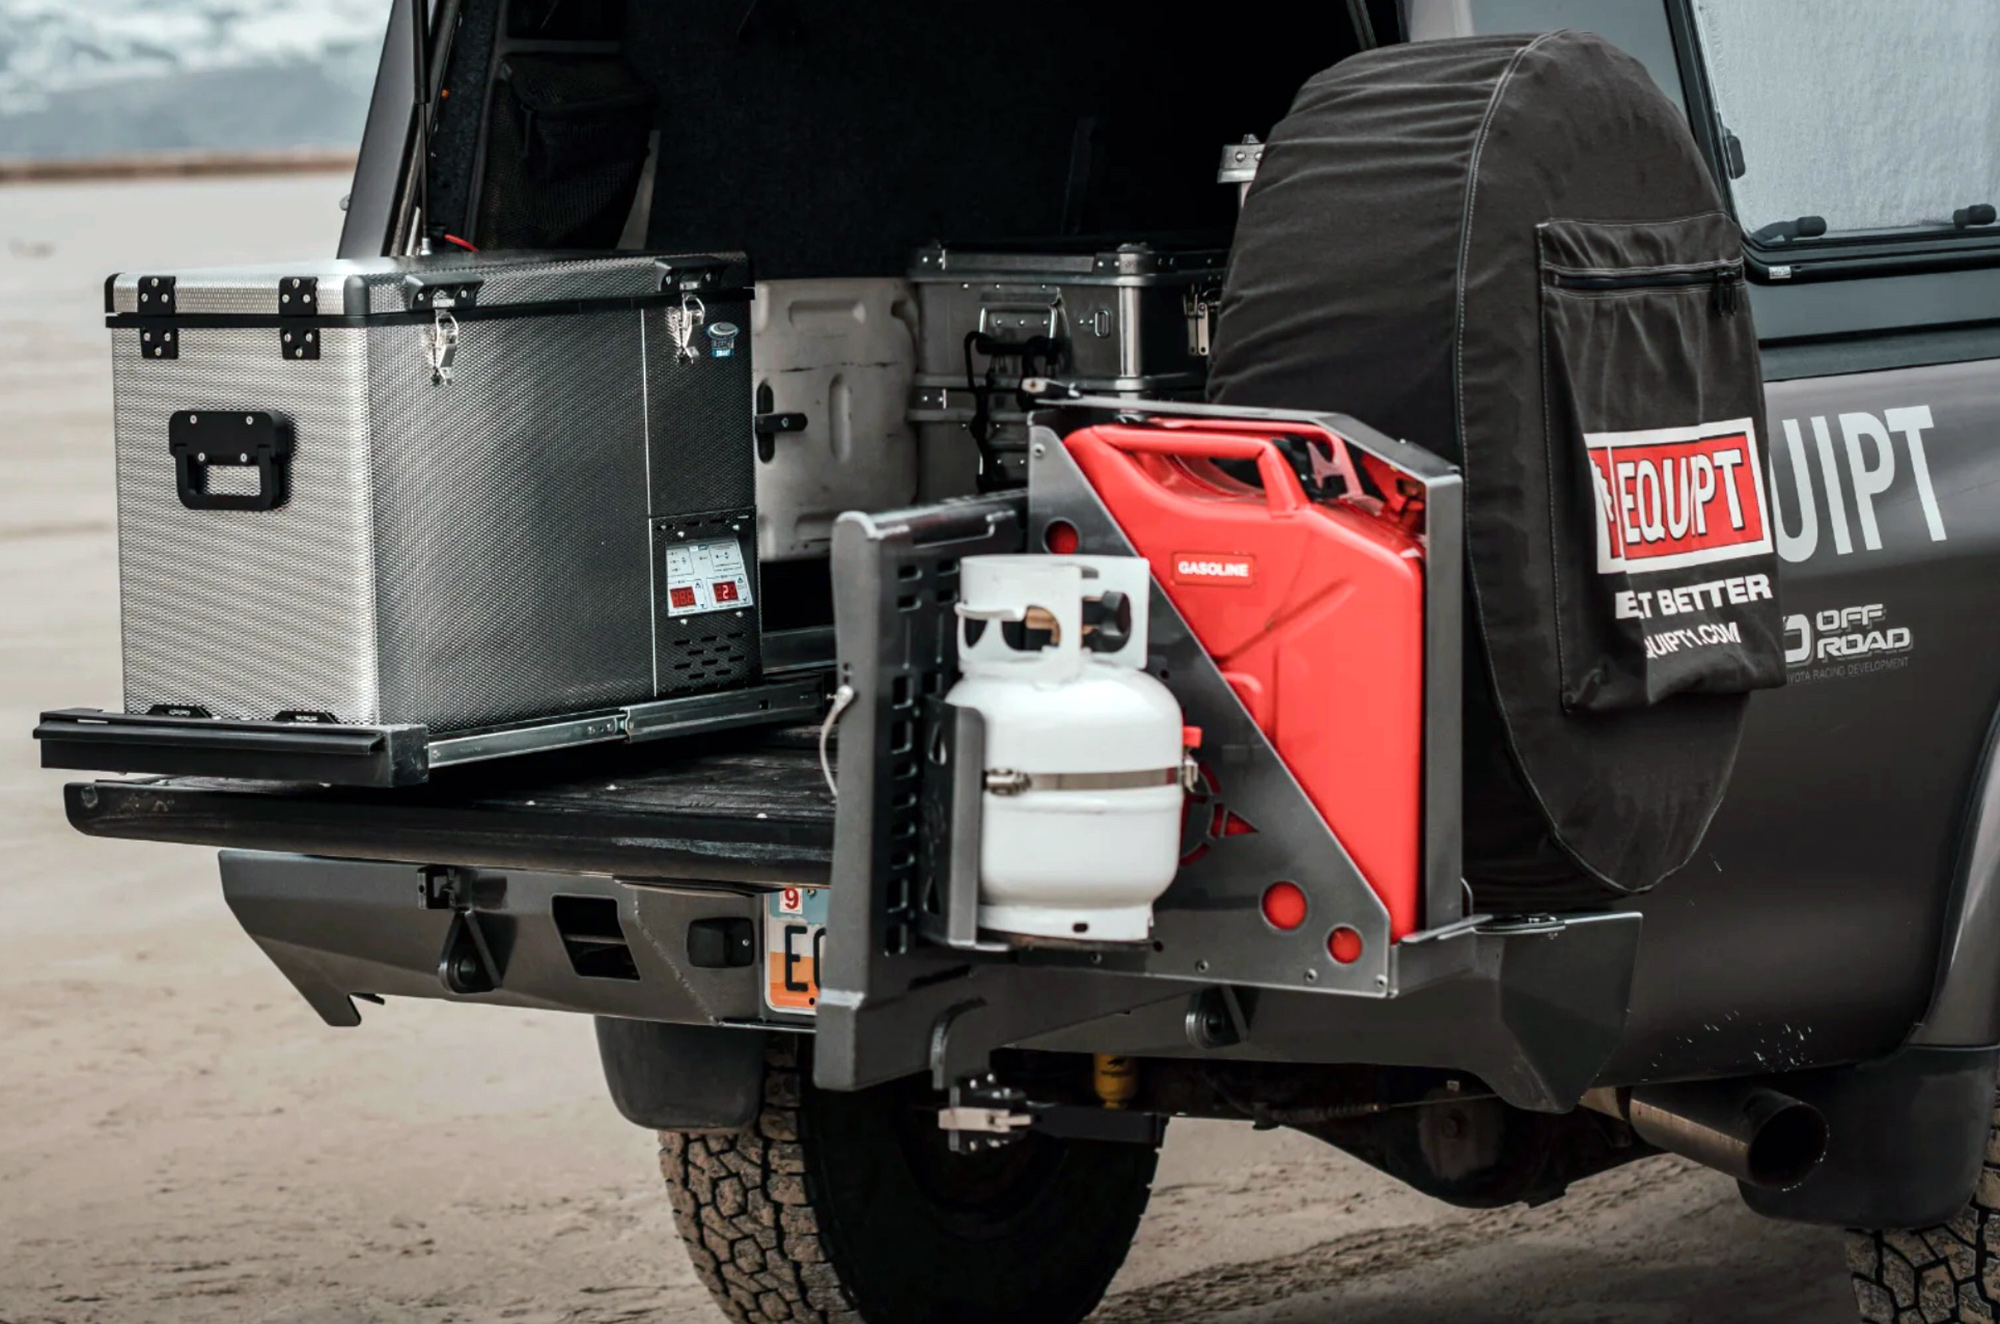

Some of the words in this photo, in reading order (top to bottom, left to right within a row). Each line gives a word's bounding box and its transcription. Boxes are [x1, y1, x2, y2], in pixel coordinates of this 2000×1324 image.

[1768, 404, 1947, 563] UIPT
[1177, 560, 1249, 578] GASOLINE
[1657, 573, 1773, 616] BETTER
[1815, 603, 1885, 633] OFF
[1816, 627, 1912, 660] ROAD
[1785, 670, 1811, 684] YOTA
[1812, 664, 1846, 681] RACING
[1848, 656, 1909, 676] DEVELOPMENT
[784, 887, 799, 910] 9
